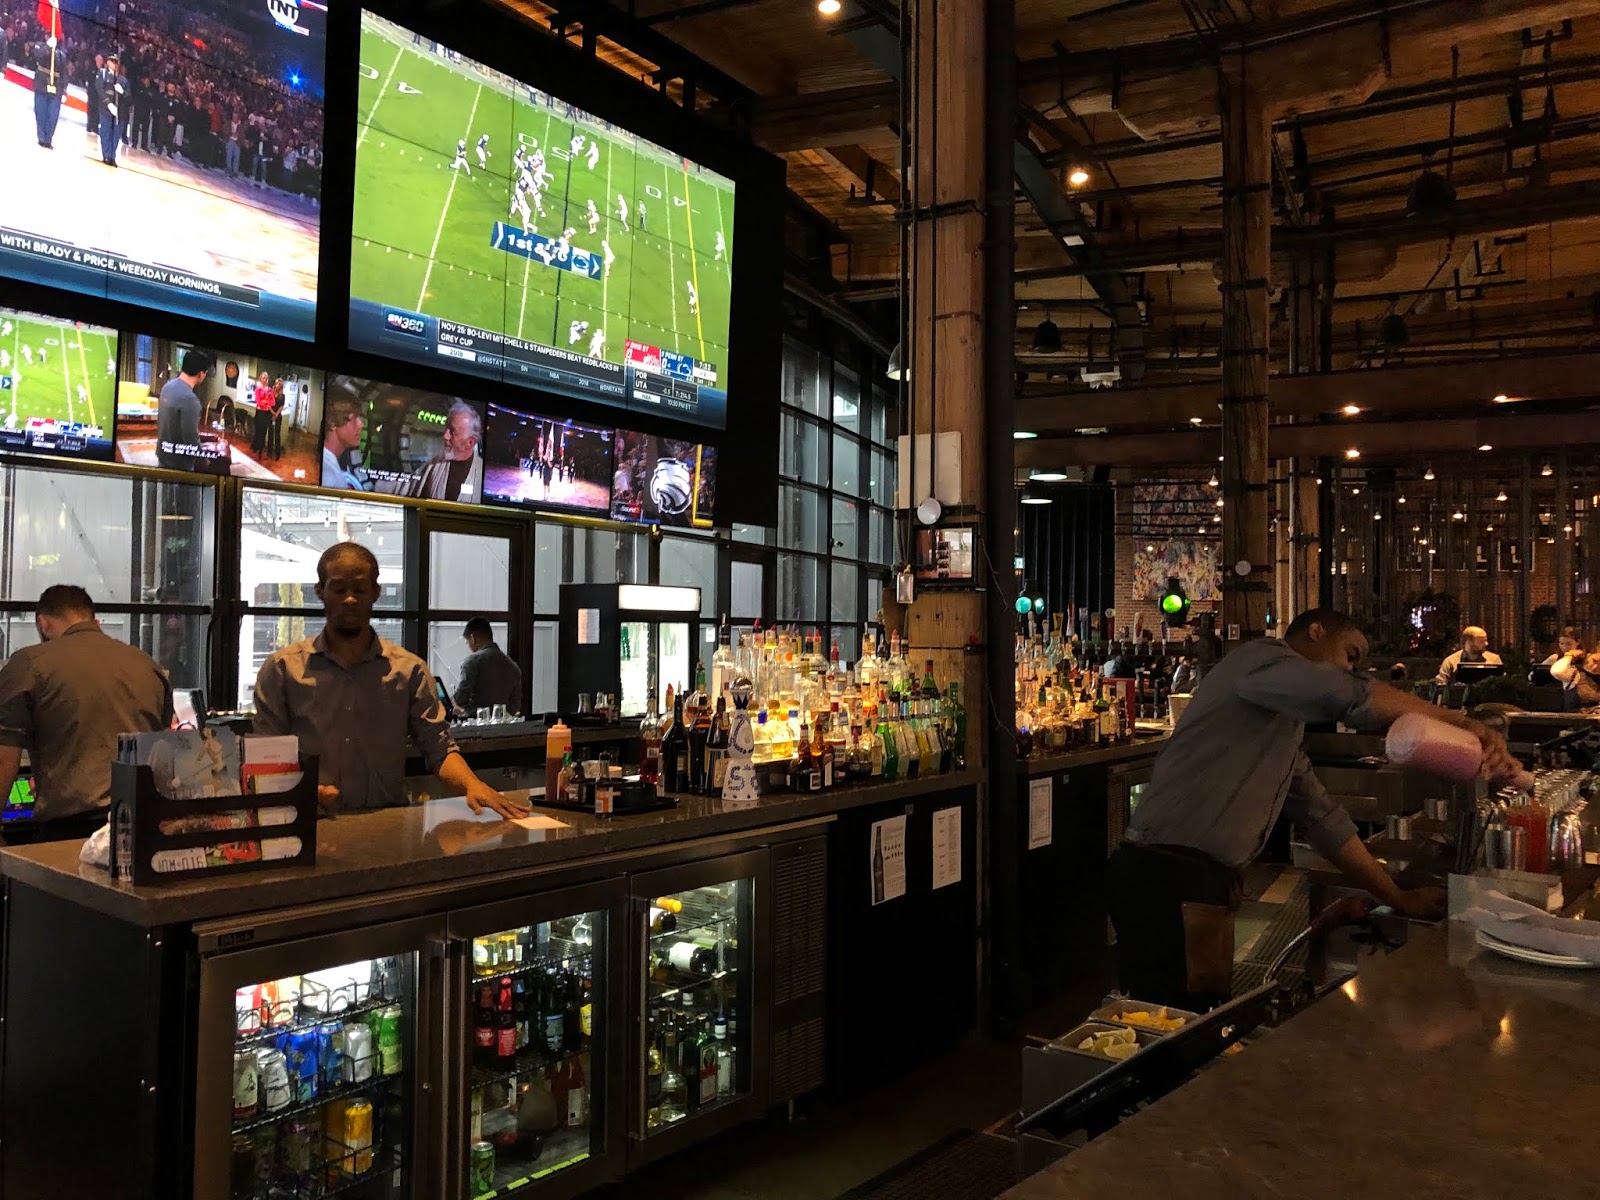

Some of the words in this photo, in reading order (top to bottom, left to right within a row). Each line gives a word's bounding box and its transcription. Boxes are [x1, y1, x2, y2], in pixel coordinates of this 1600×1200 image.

[507, 233, 533, 252] 1st
[0, 232, 31, 250] WITH
[33, 241, 71, 260] BRADY
[73, 252, 82, 262] &
[84, 252, 118, 271] PRICE,
[119, 262, 168, 281] WEEKDAY
[169, 273, 222, 295] MORNINGS,
[440, 332, 459, 343] GREY
[459, 336, 474, 347] CUP
[440, 322, 456, 332] NOV
[466, 328, 492, 341] BO-LEVI
[493, 334, 524, 349] MITCHELL
[530, 344, 567, 359] STAMPEDERS
[568, 353, 582, 363] BEAT
[582, 356, 613, 370] REDBLACKS
[450, 348, 464, 357] 2018
[476, 354, 507, 367] @SNSTATS
[662, 358, 668, 368] 0
[635, 370, 648, 379] POR
[635, 380, 648, 389] UTA
